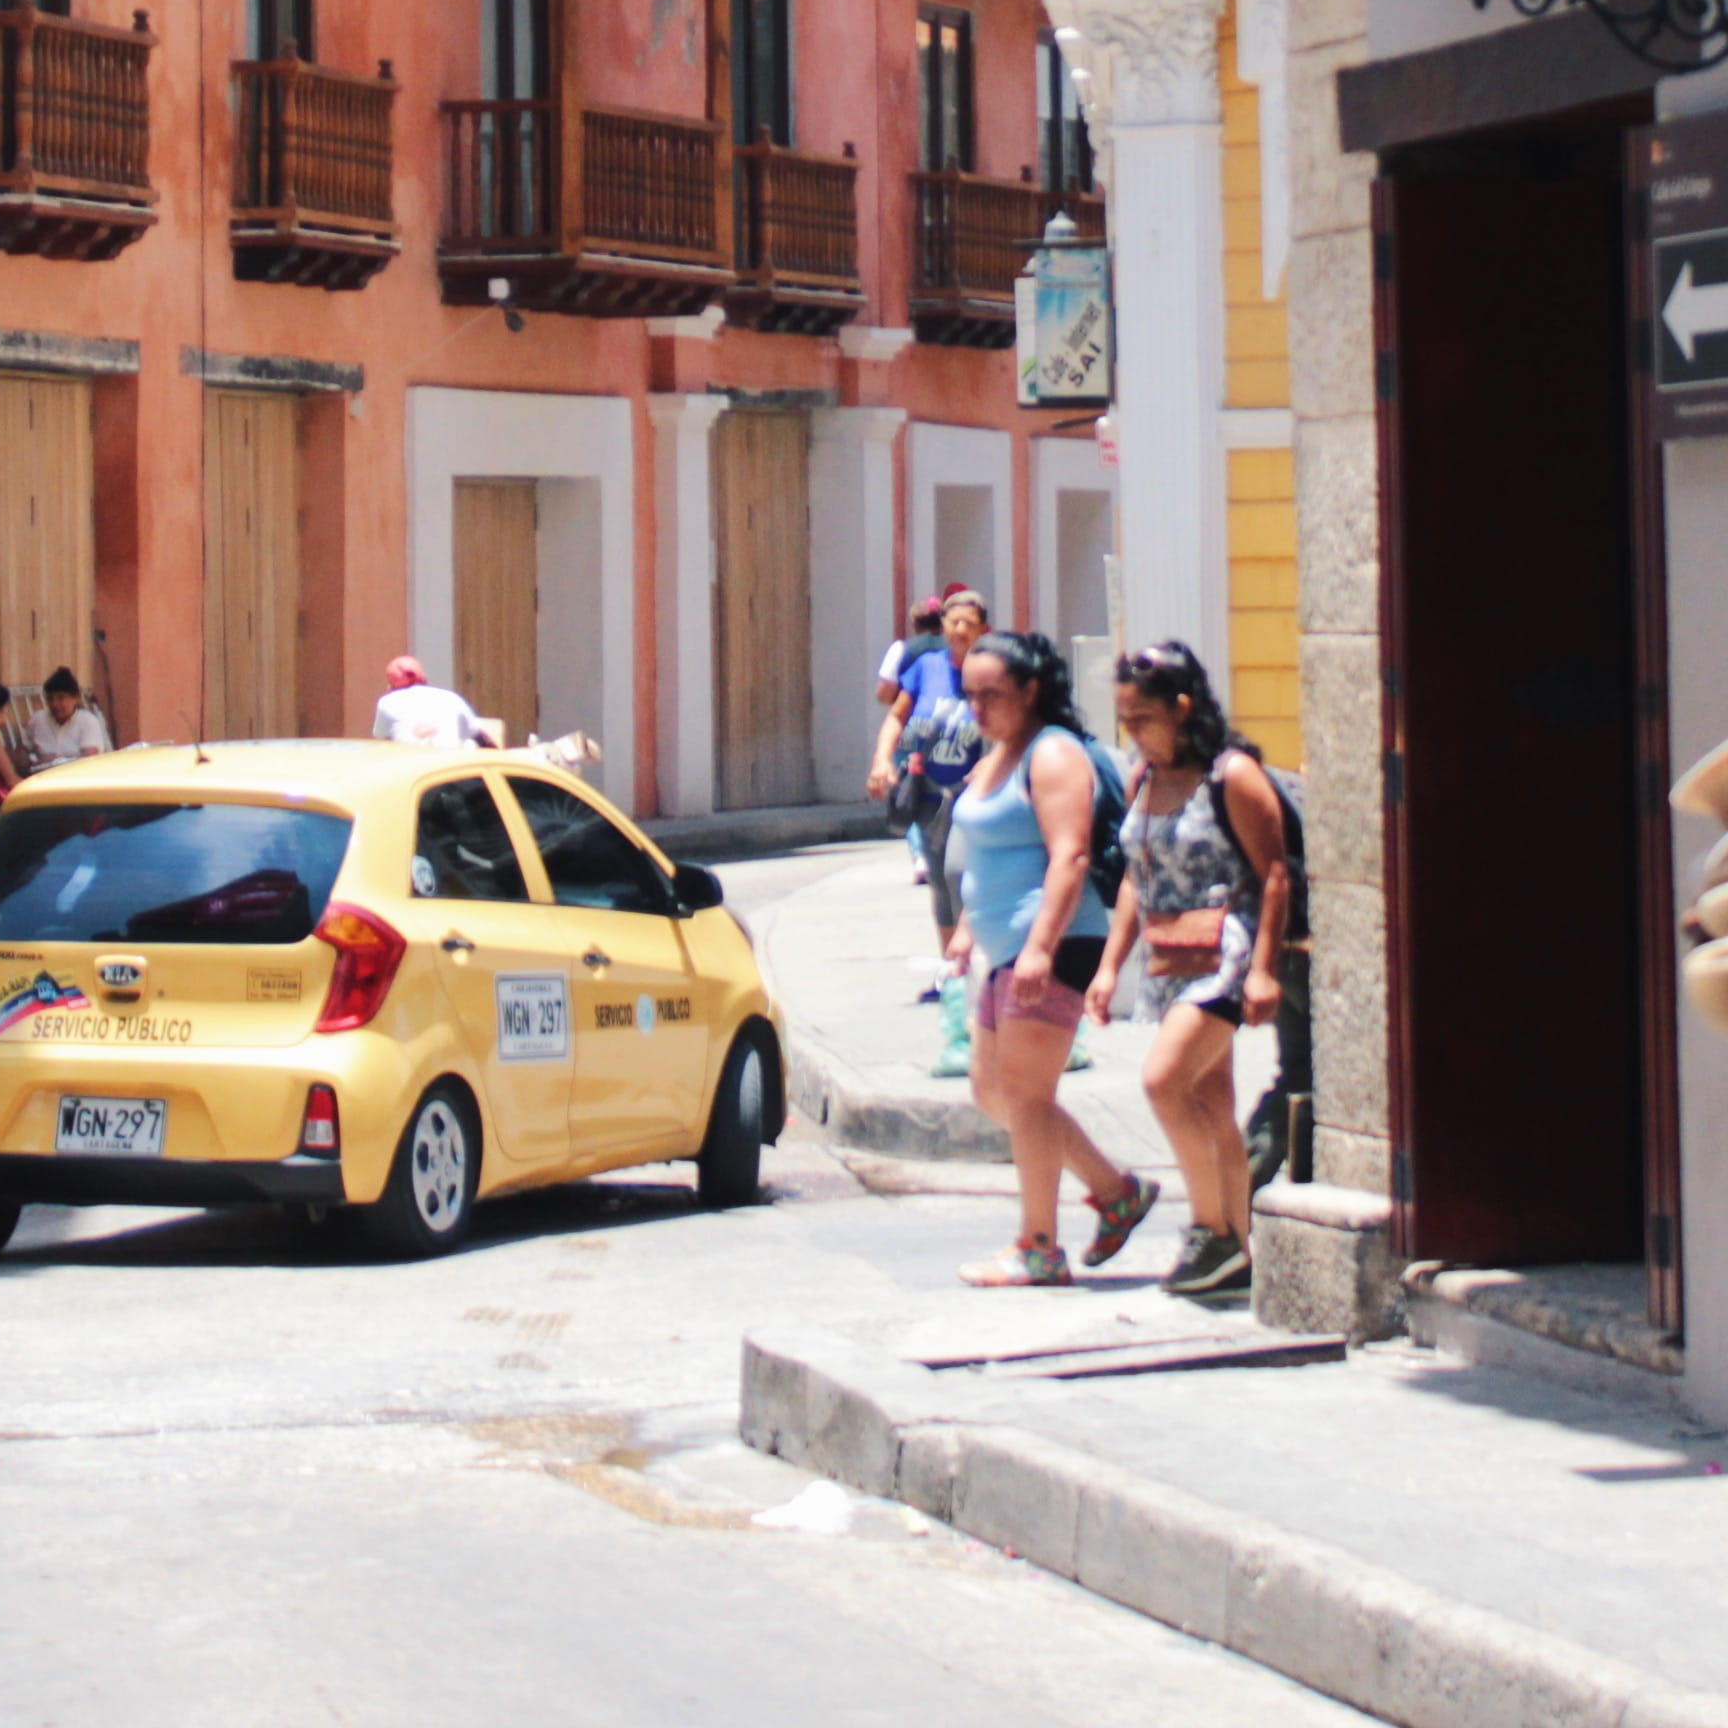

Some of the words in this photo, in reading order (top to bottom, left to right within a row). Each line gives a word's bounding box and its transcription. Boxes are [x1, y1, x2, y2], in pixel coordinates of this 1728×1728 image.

[104, 966, 136, 983] KIA
[32, 1015, 110, 1040] SERVICIO
[502, 1000, 531, 1036] WGN
[538, 998, 562, 1035] 297
[594, 1003, 633, 1029] SERVICIO
